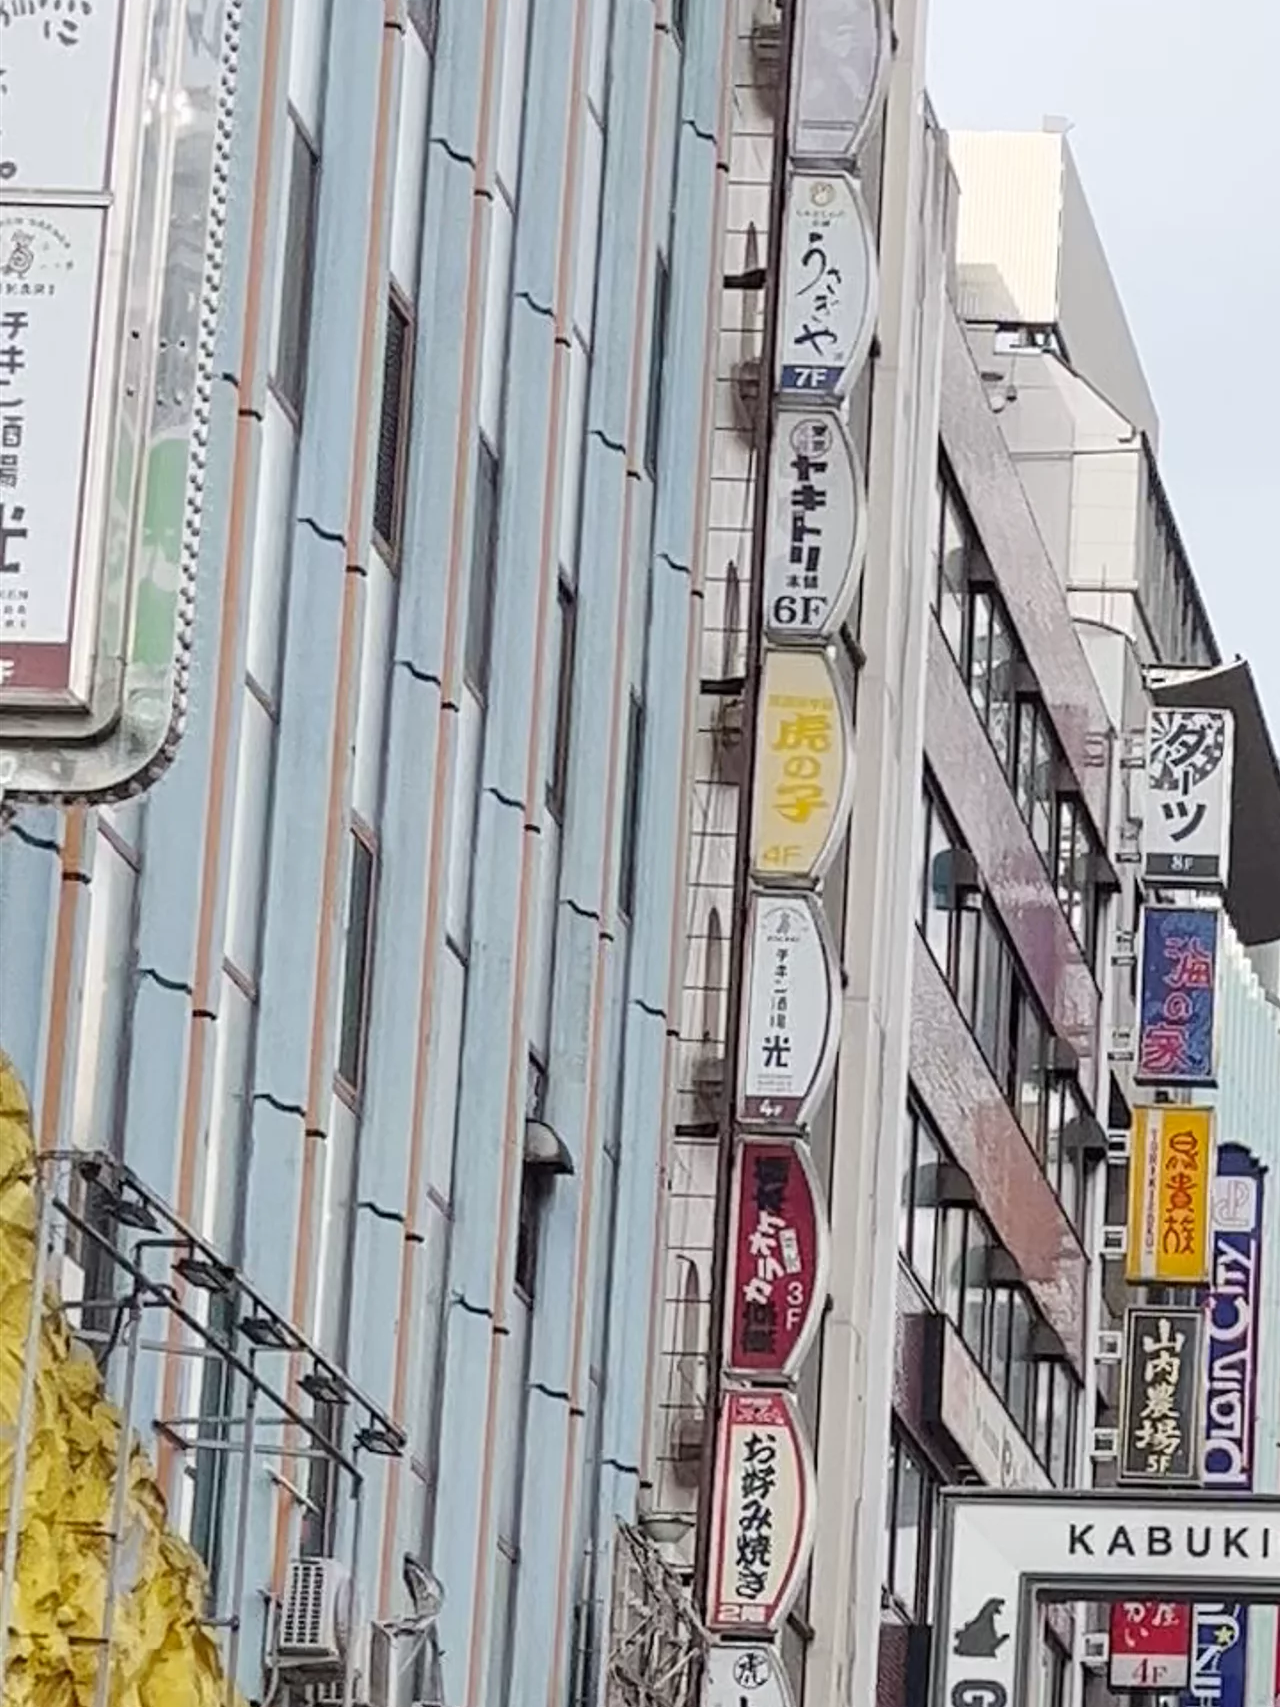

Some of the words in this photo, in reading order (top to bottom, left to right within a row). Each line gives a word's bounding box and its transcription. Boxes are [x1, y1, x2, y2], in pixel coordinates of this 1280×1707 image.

[795, 369, 826, 388] 7F
[773, 596, 828, 626] 6F
[1166, 722, 1208, 842] ダーツ
[1141, 935, 1211, 1072] 海の家
[762, 1034, 793, 1068] 光
[1135, 1317, 1185, 1455] 山内農場
[736, 1433, 777, 1600] お好み焼き
[1130, 1659, 1167, 1684] 4F
